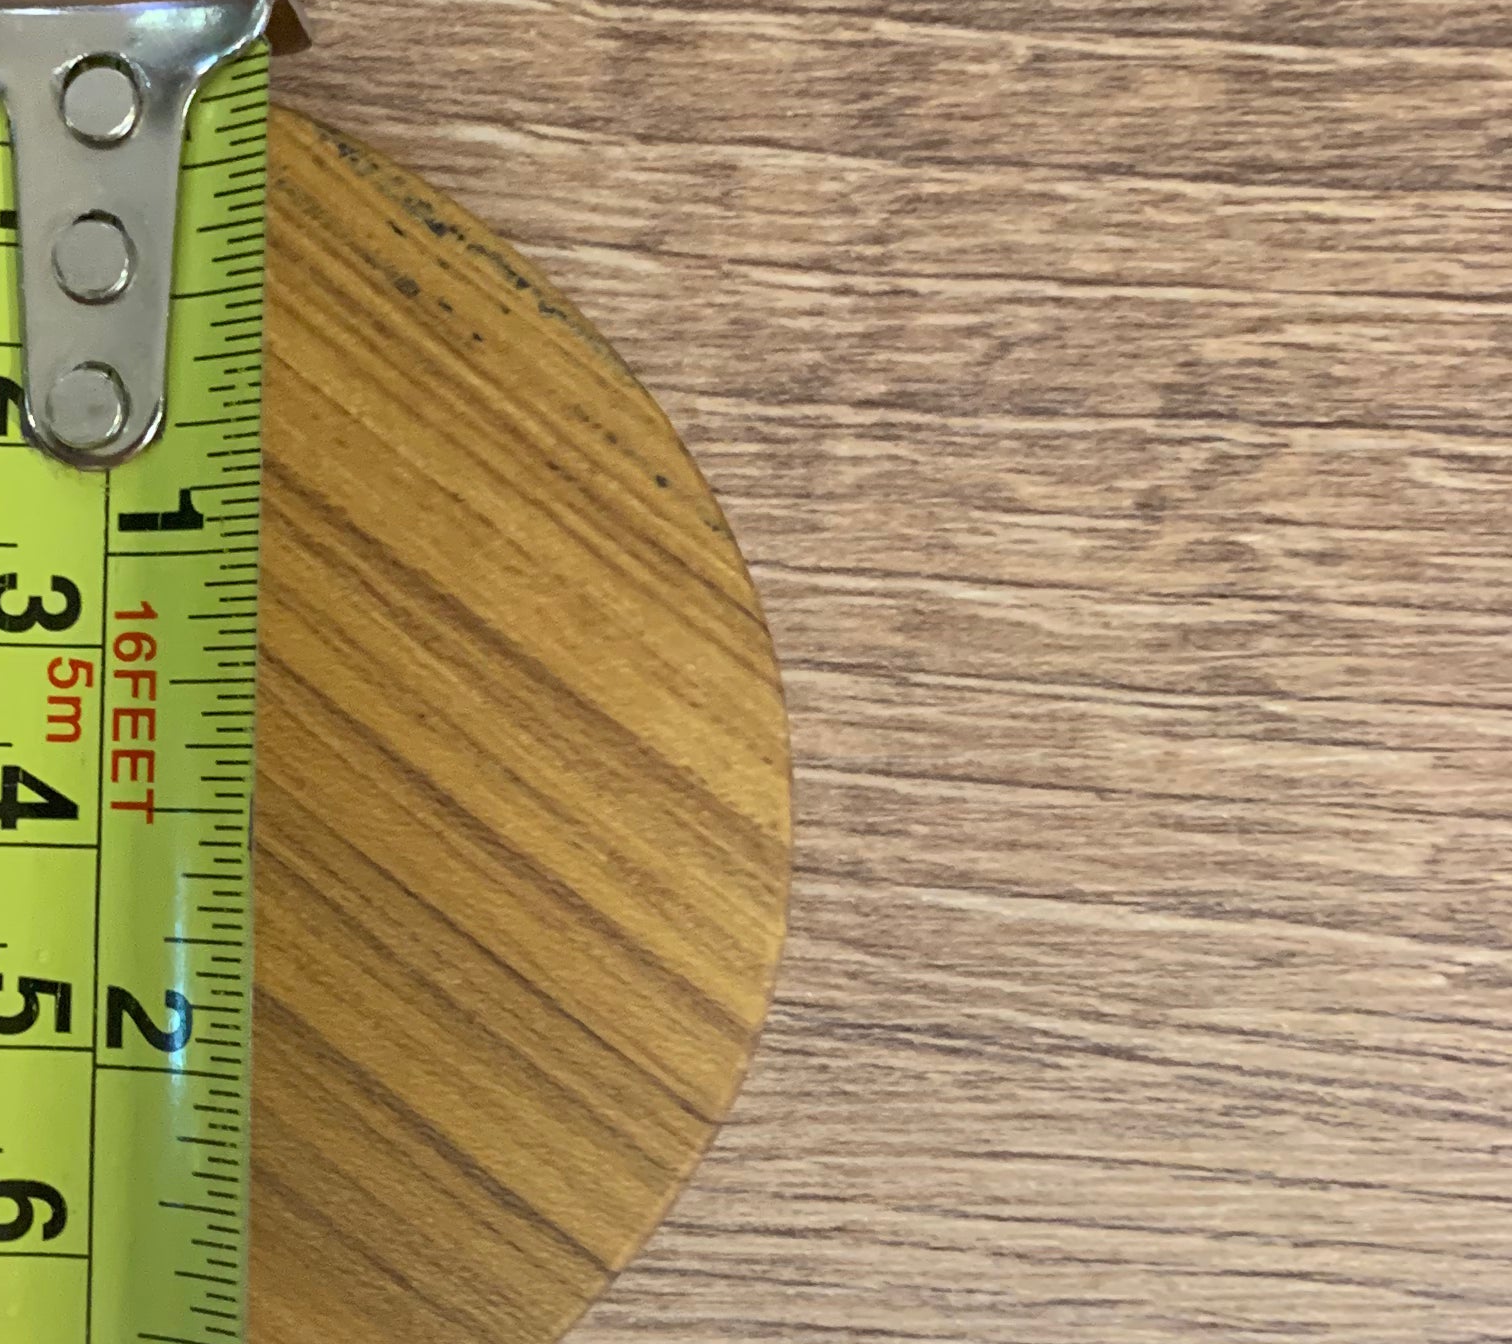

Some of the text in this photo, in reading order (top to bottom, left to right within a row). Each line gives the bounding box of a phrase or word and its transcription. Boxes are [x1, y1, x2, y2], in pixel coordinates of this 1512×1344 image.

[118, 488, 204, 531] 1
[45, 656, 95, 744] 5m
[106, 985, 194, 1053] 2
